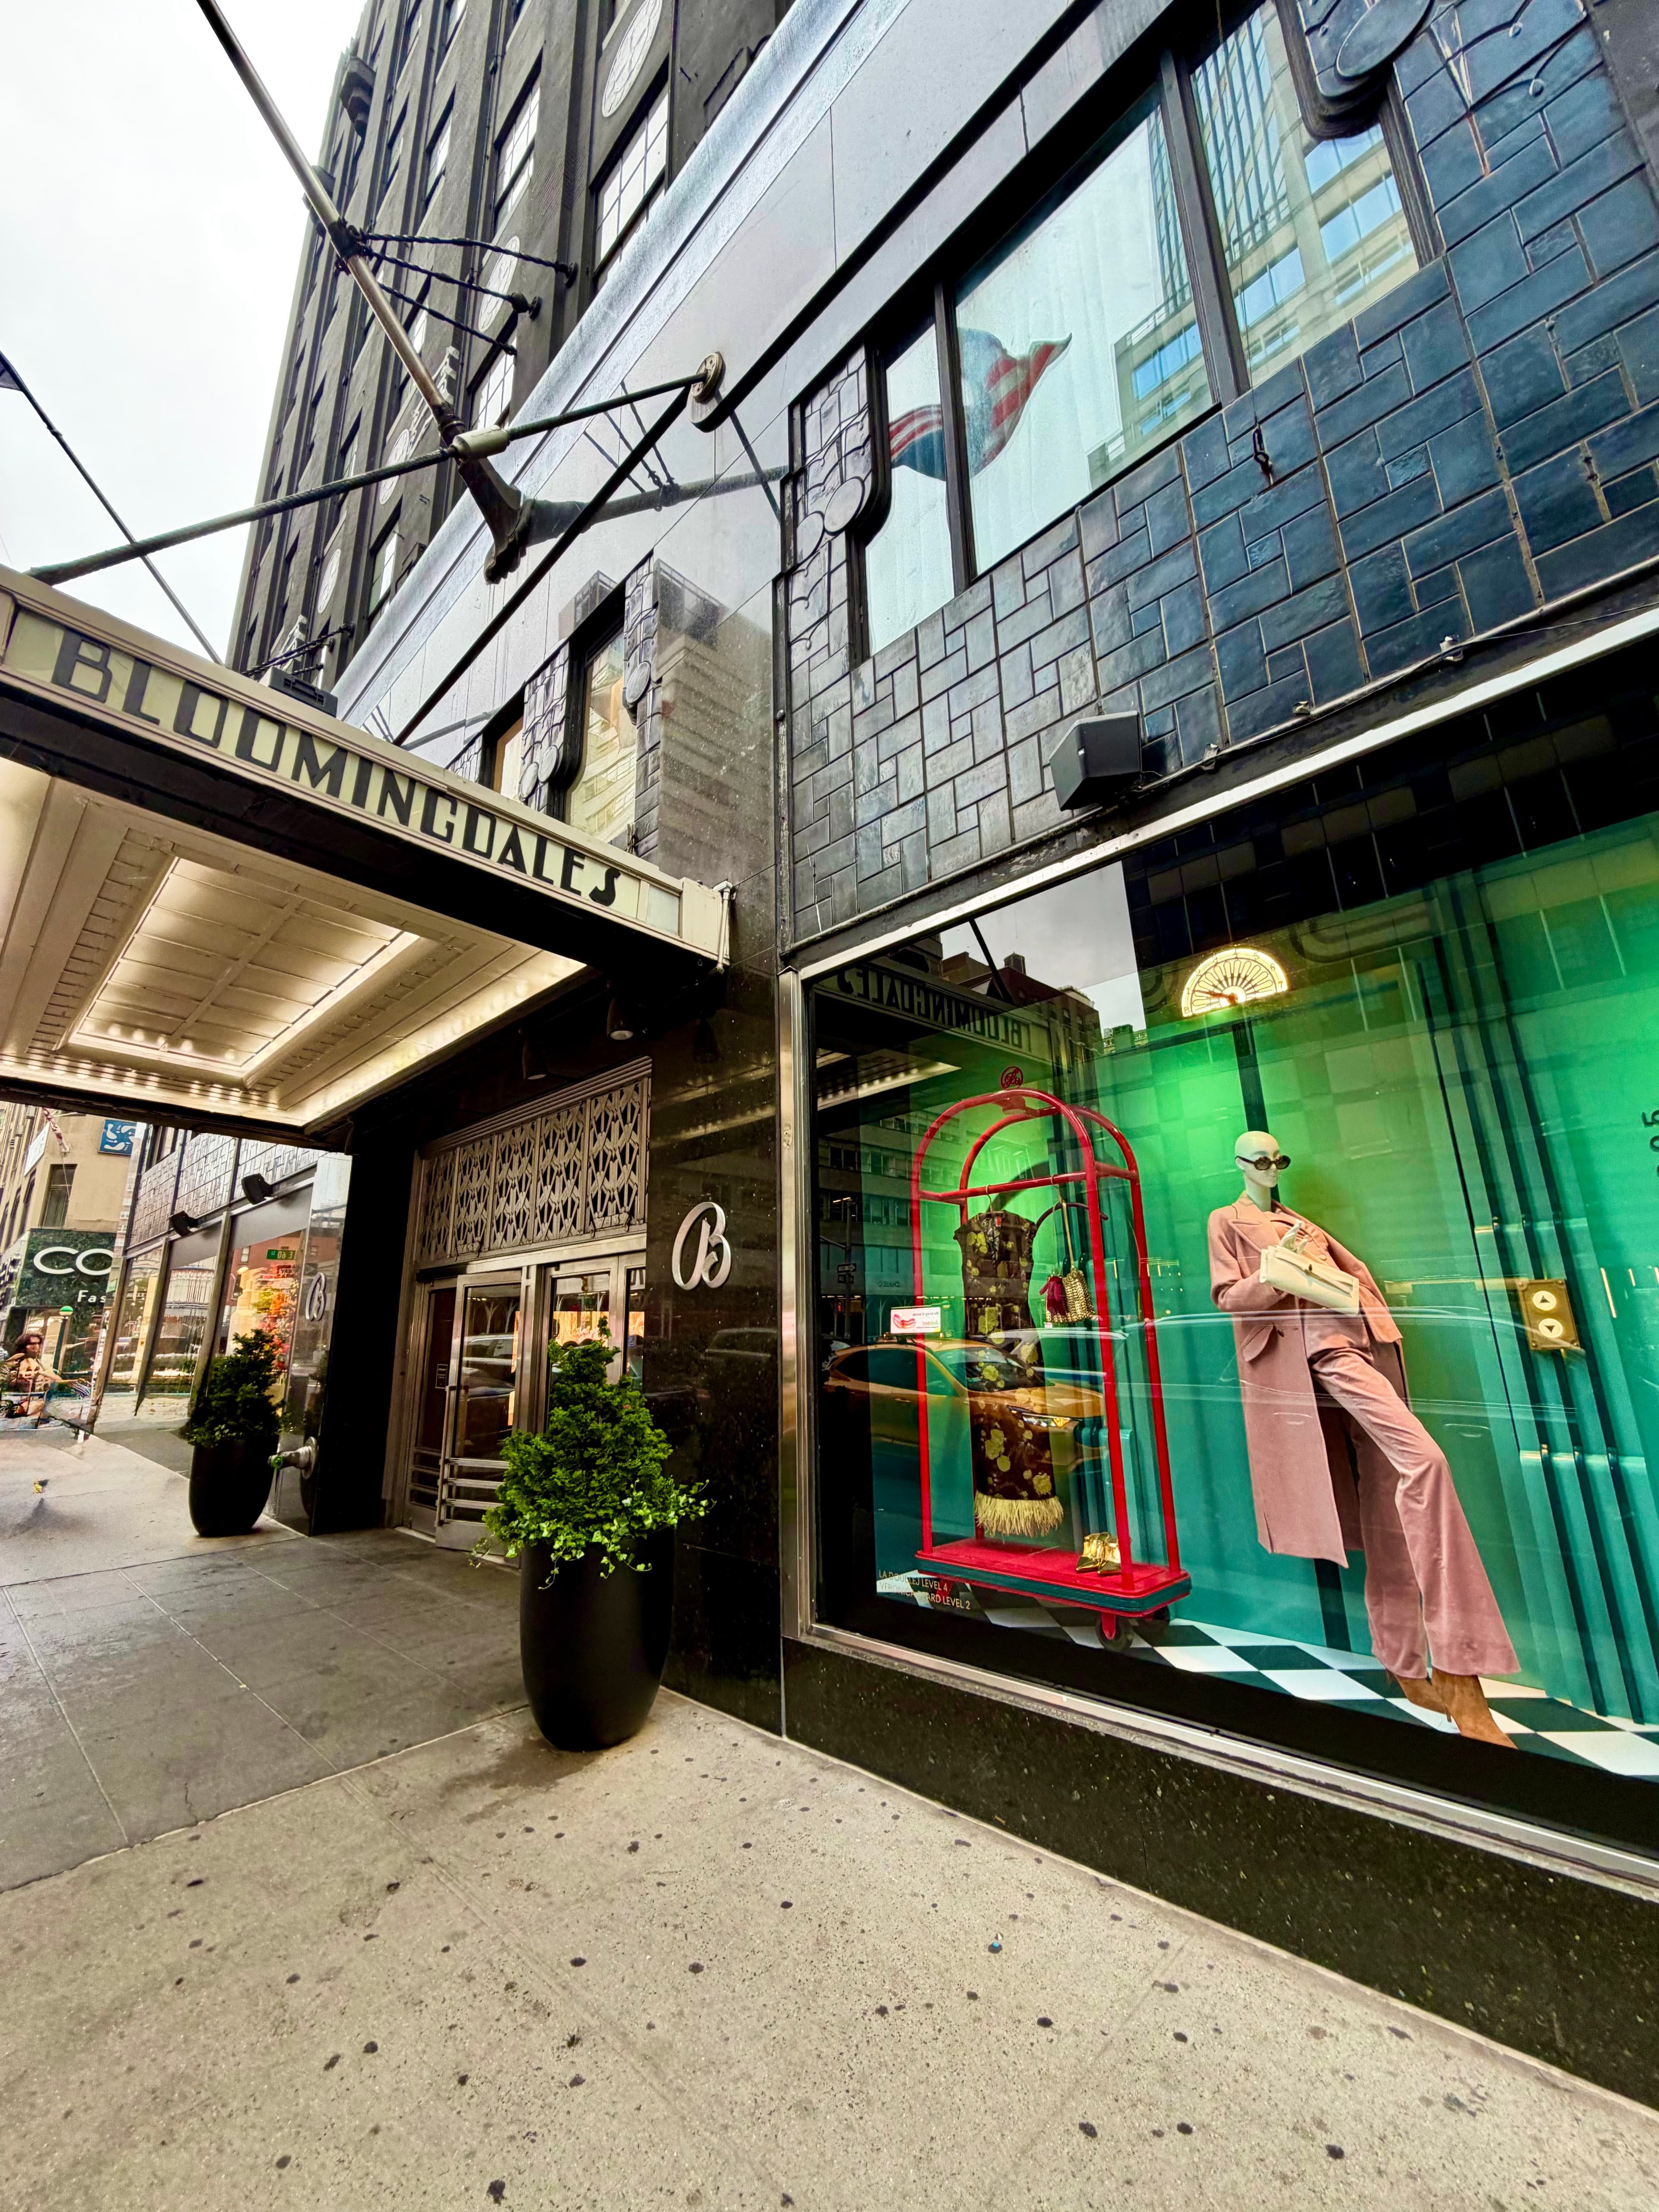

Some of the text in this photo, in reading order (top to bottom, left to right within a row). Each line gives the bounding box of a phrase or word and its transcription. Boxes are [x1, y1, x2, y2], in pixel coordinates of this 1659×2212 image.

[51, 631, 621, 907] BLOOMINGDALES
[672, 1201, 731, 1290] B
[879, 1569, 887, 1578] LA
[922, 1579, 941, 1591] LEVEL
[943, 1583, 948, 1592] 4
[943, 1594, 964, 1609] LEVEL
[966, 1601, 971, 1610] 2
